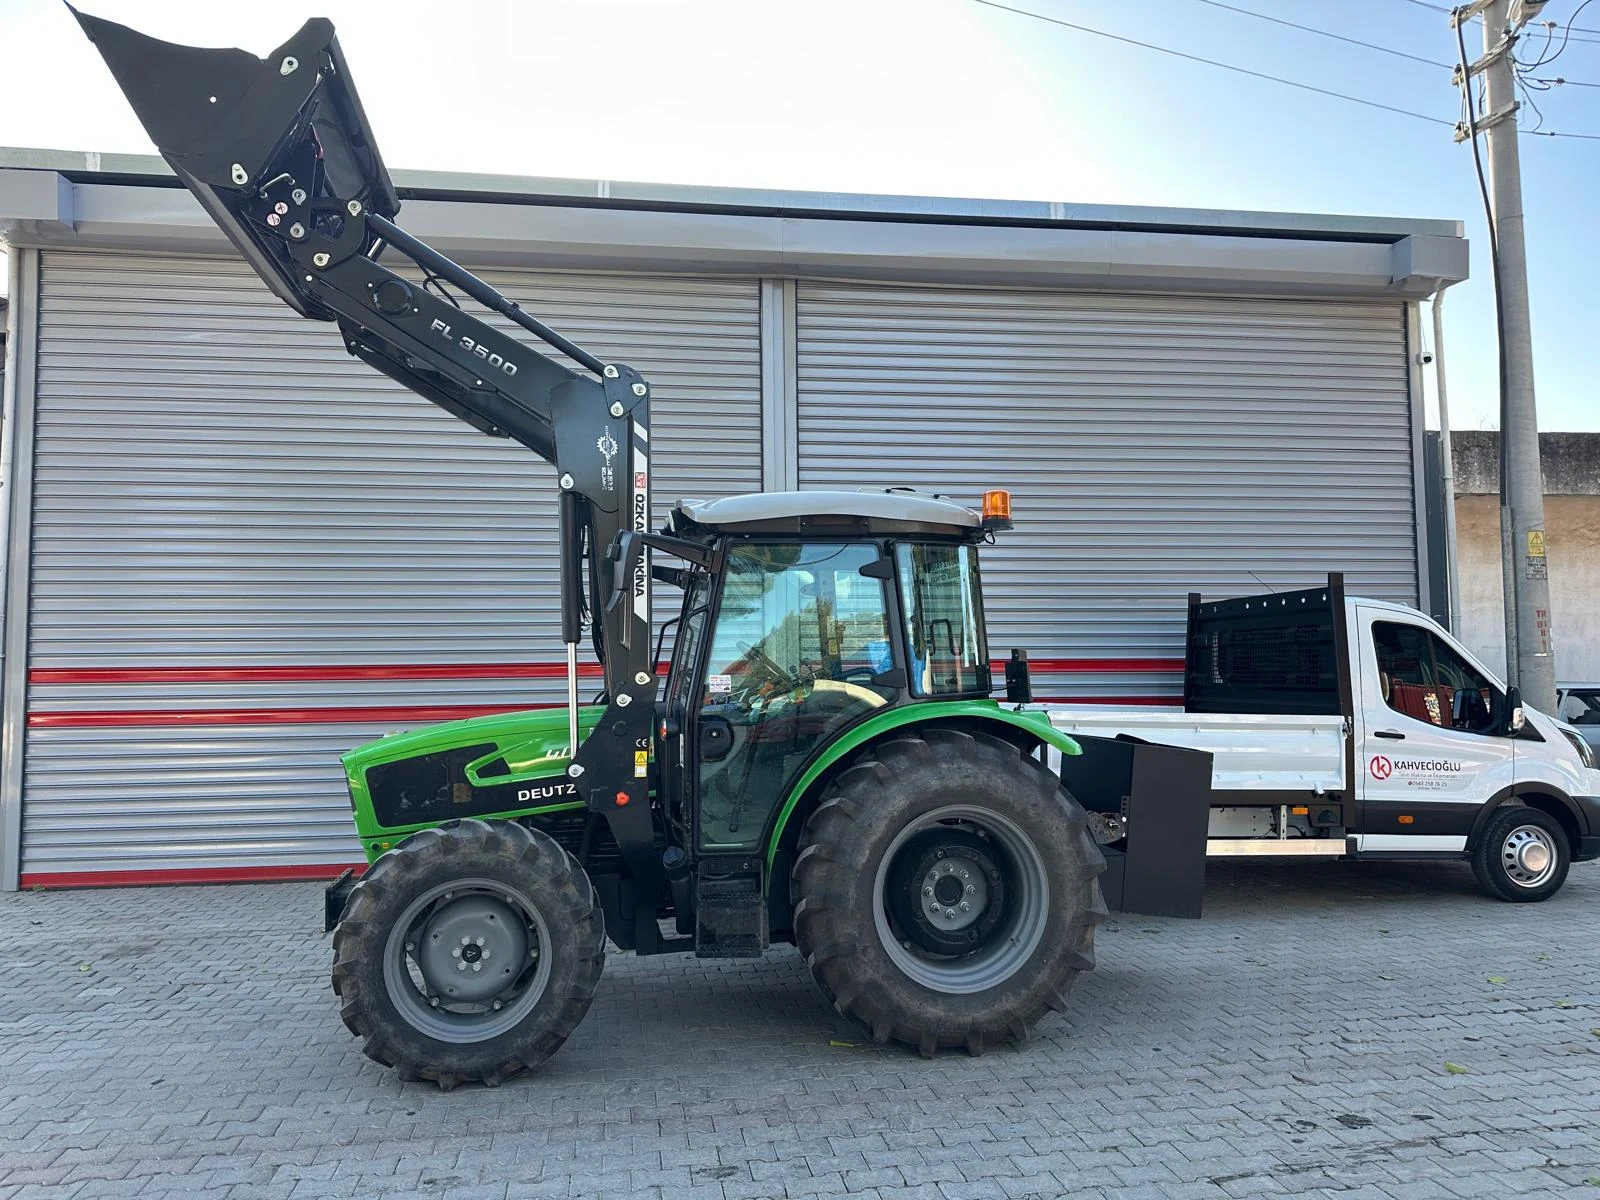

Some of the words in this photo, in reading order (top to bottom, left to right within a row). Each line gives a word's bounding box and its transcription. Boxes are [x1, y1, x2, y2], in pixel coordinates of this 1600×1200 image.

[431, 319, 453, 340] FL
[459, 336, 518, 377] 3500
[635, 493, 646, 534] ÖZKA
[635, 550, 647, 597] AKİNA
[636, 738, 647, 747] CE
[1394, 760, 1461, 772] KAHVECİOĞLU
[518, 783, 576, 801] DEUTZ
